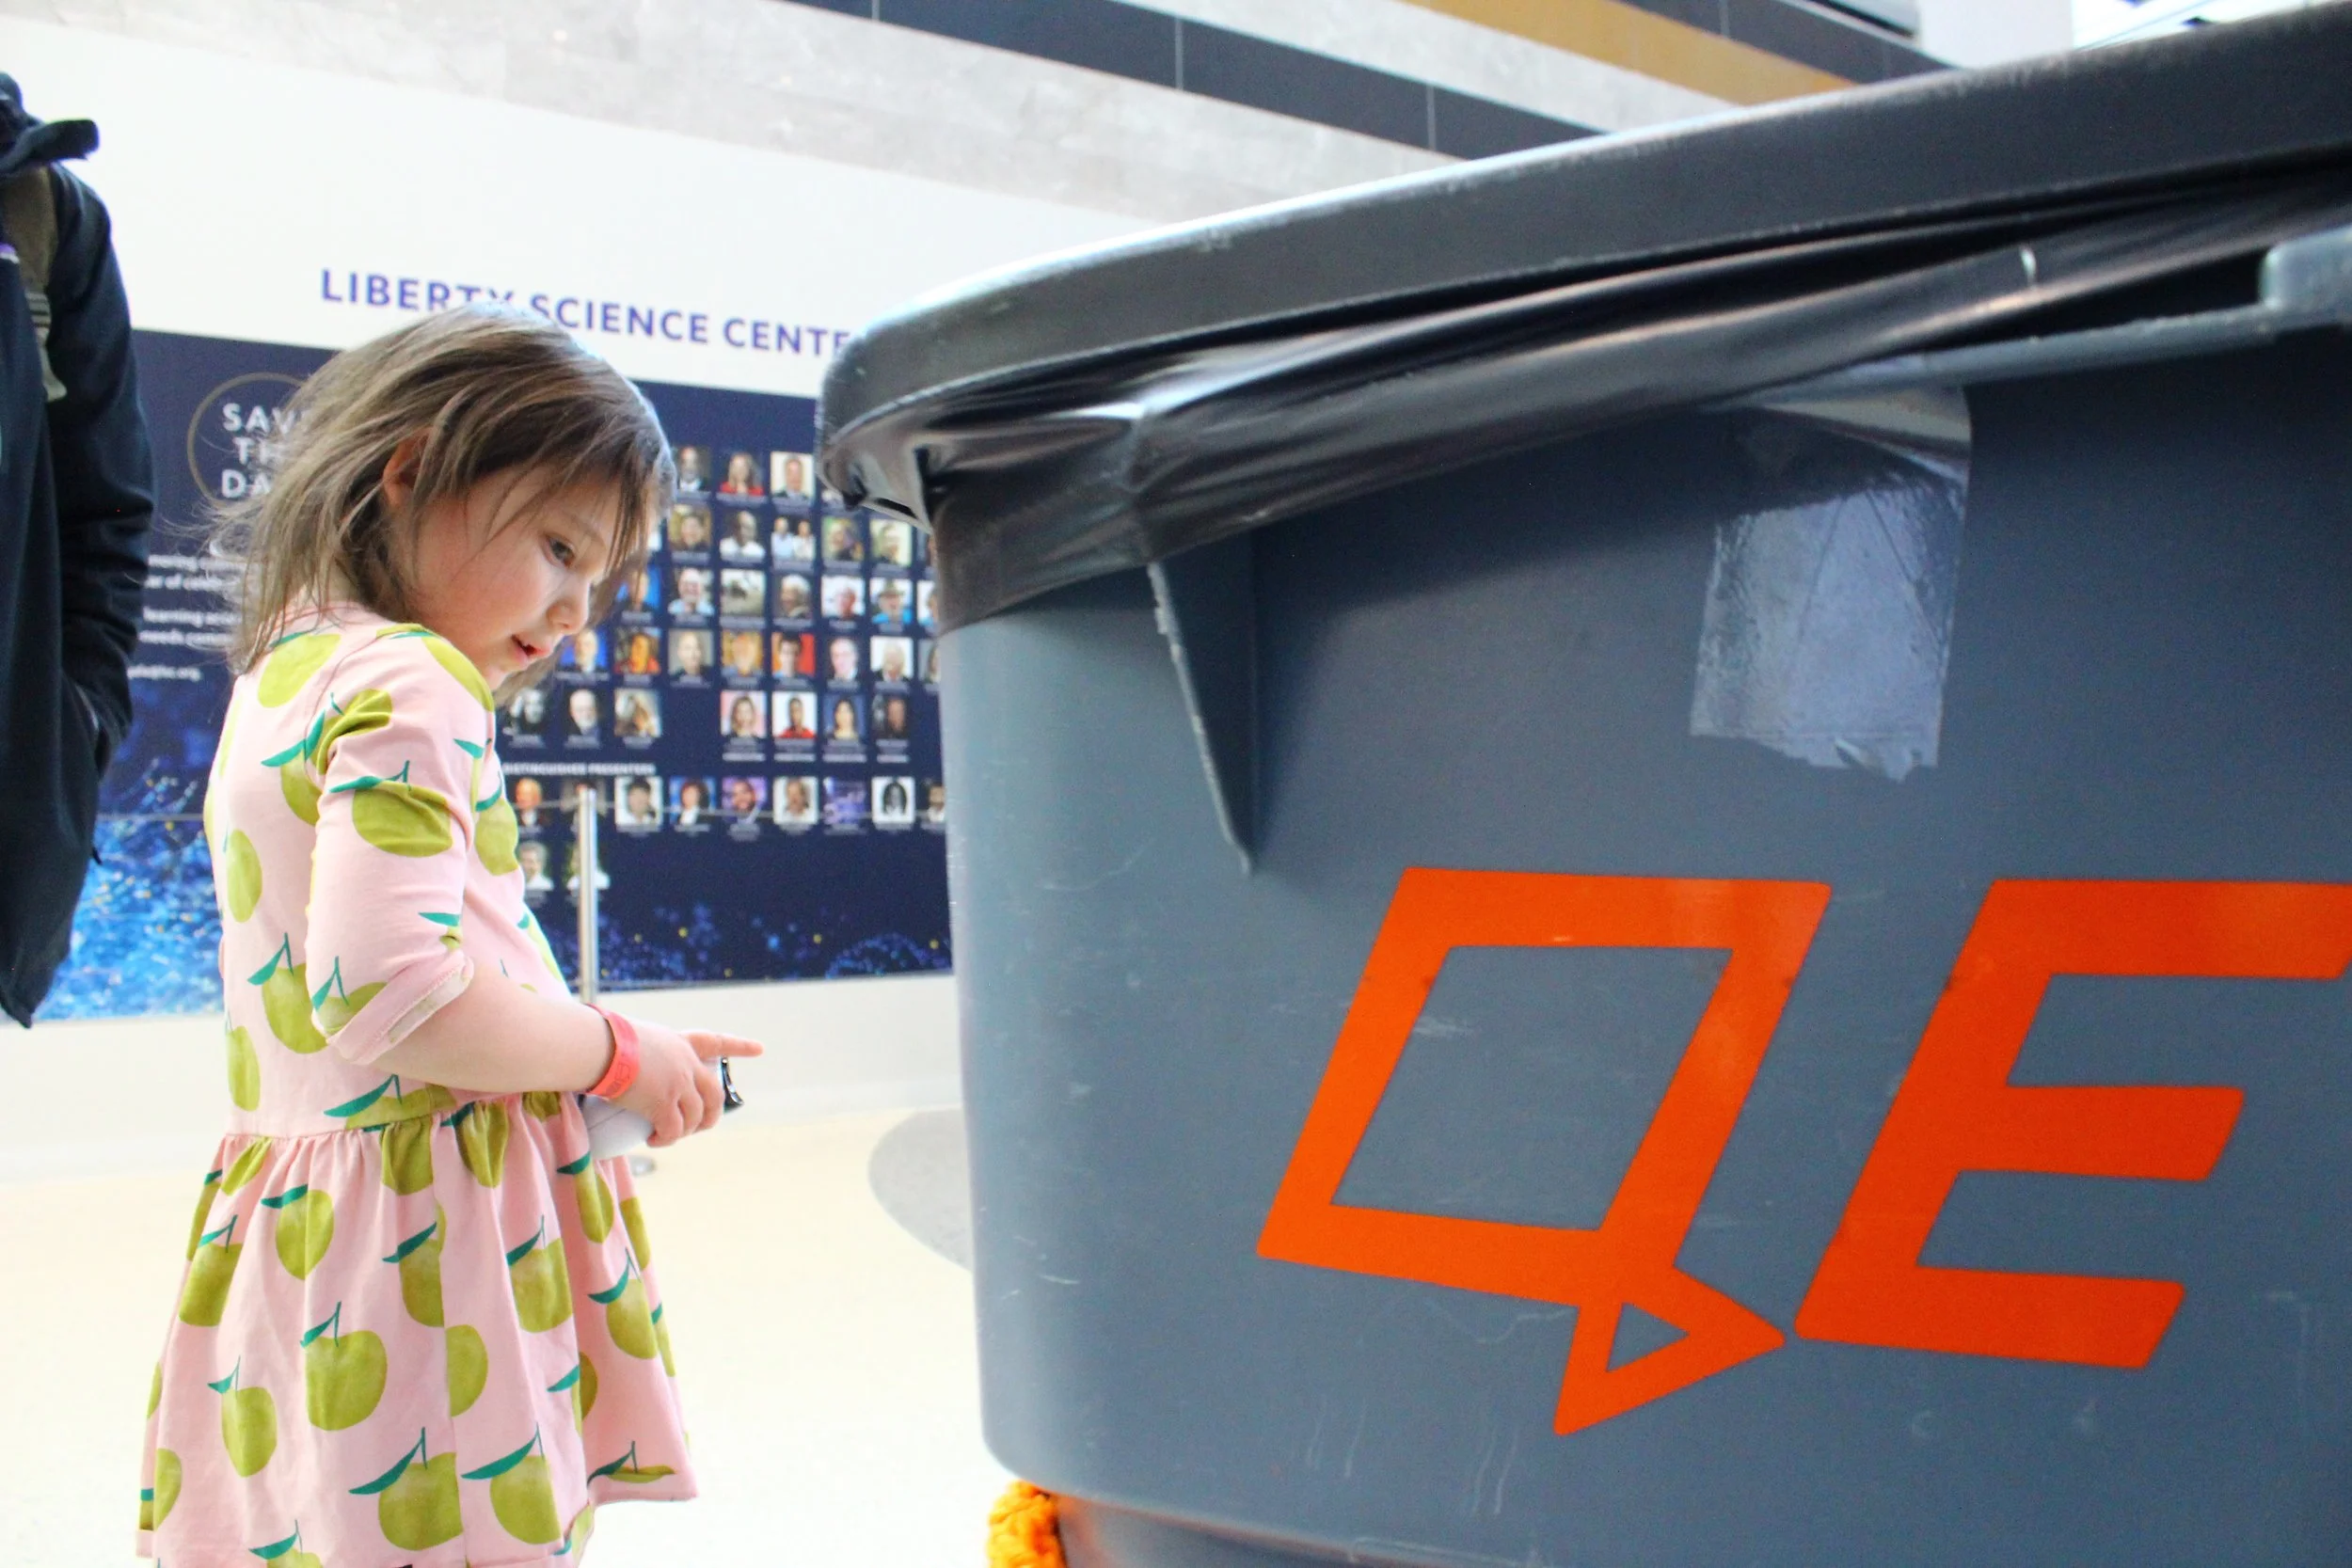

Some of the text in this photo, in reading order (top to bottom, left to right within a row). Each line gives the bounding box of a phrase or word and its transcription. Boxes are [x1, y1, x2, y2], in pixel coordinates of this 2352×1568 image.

[530, 293, 708, 343] SCIENCE
[723, 319, 850, 357] CENT
[222, 402, 309, 436] SAV
[233, 436, 290, 466] TH
[221, 468, 273, 499] DA
